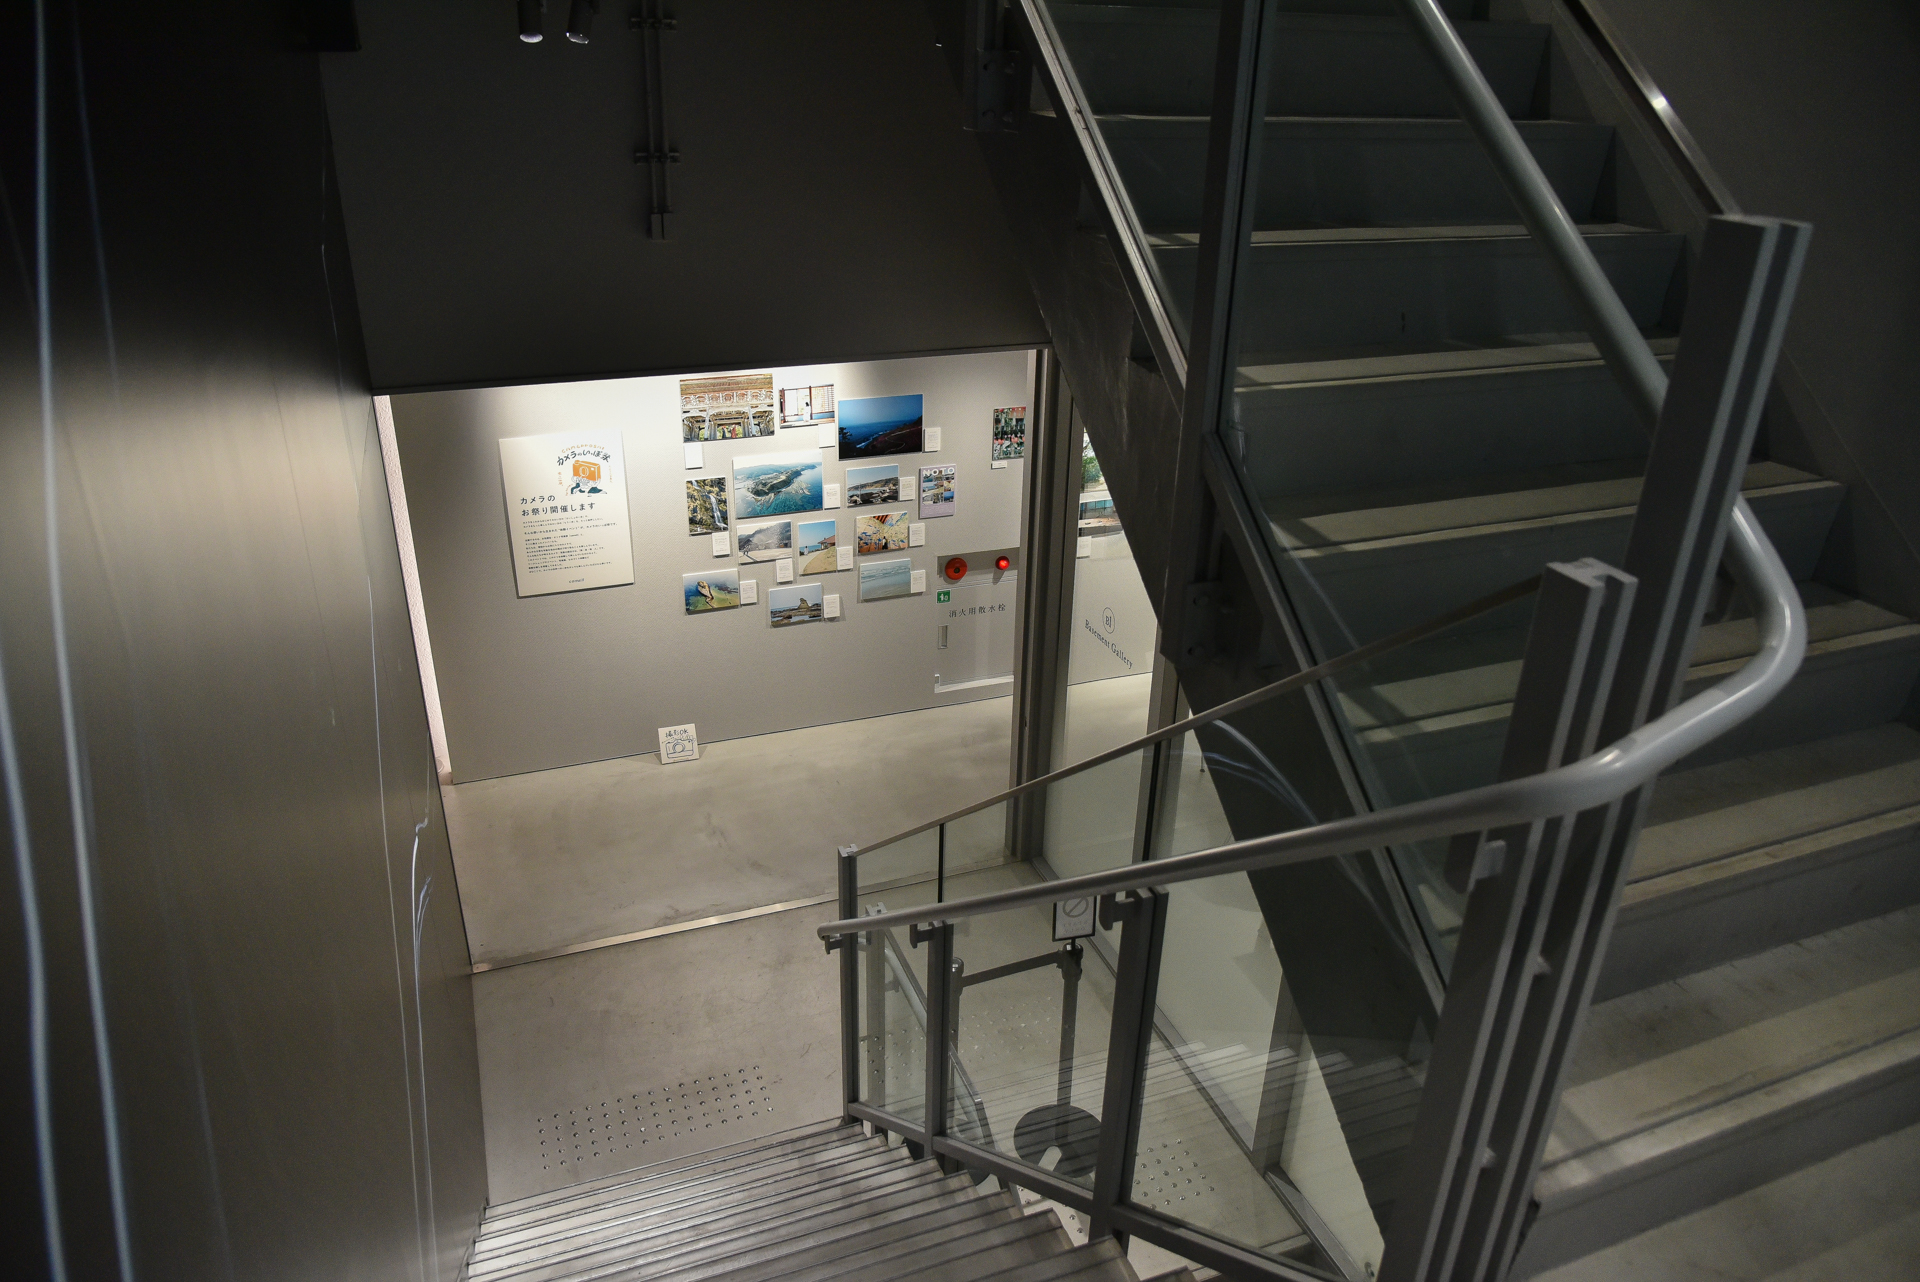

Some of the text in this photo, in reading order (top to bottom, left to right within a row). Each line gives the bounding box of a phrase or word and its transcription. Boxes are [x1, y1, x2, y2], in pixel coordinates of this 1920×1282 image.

[922, 467, 955, 477] NOTO
[520, 495, 556, 505] カメラの
[521, 502, 596, 517] お祭り開催します
[948, 603, 1007, 619] 消火用散水栓
[1084, 619, 1133, 670] Basement Gallery
